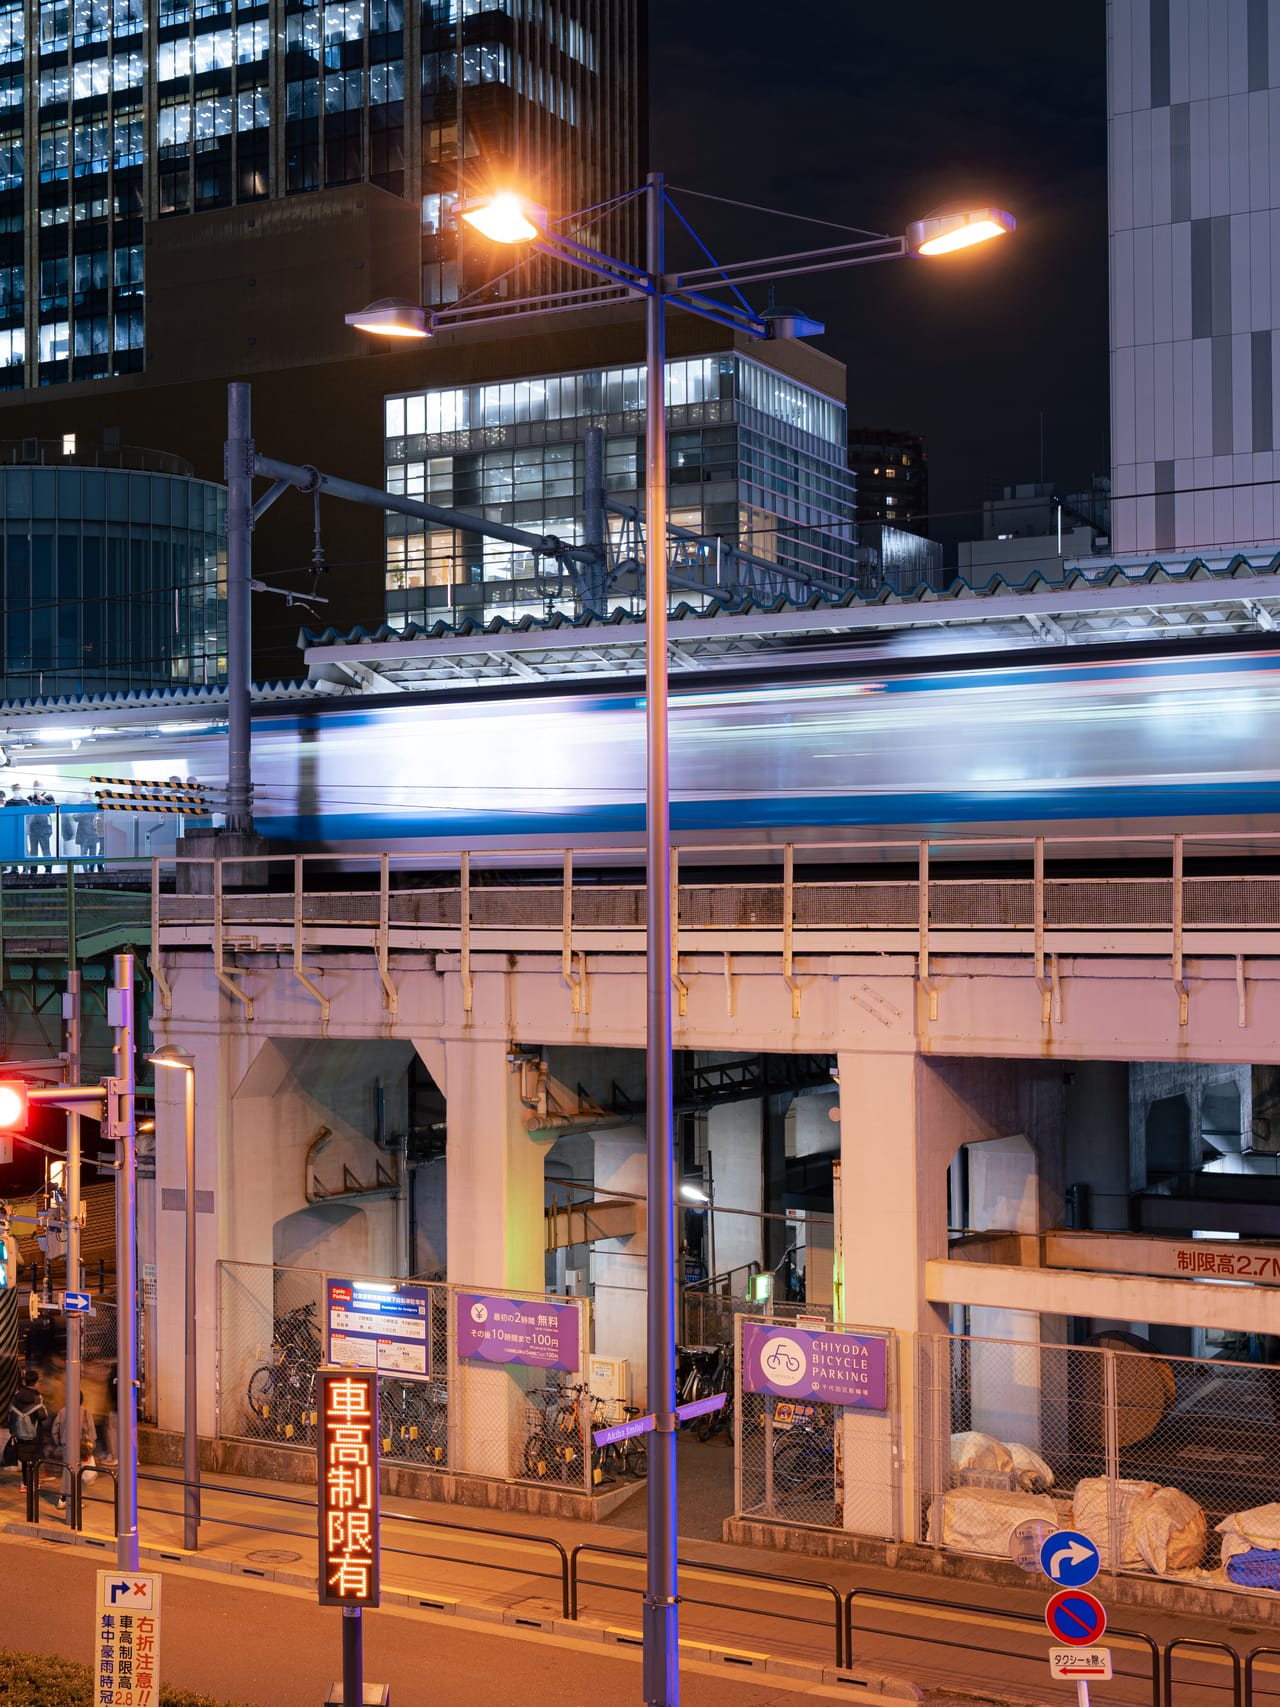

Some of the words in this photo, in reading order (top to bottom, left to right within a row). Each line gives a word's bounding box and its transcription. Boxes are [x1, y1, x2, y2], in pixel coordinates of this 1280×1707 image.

[537, 1314, 559, 1328] 無料
[812, 1340, 869, 1357] CHIYODA
[812, 1354, 868, 1370] BICYCLE
[812, 1367, 868, 1383] PARKING
[327, 1378, 372, 1597] 車高制限有
[100, 1614, 115, 1707] 集中豪雨時冠
[134, 1616, 156, 1707] 右折注意!!
[1055, 1654, 1105, 1666] タクシーを除く
